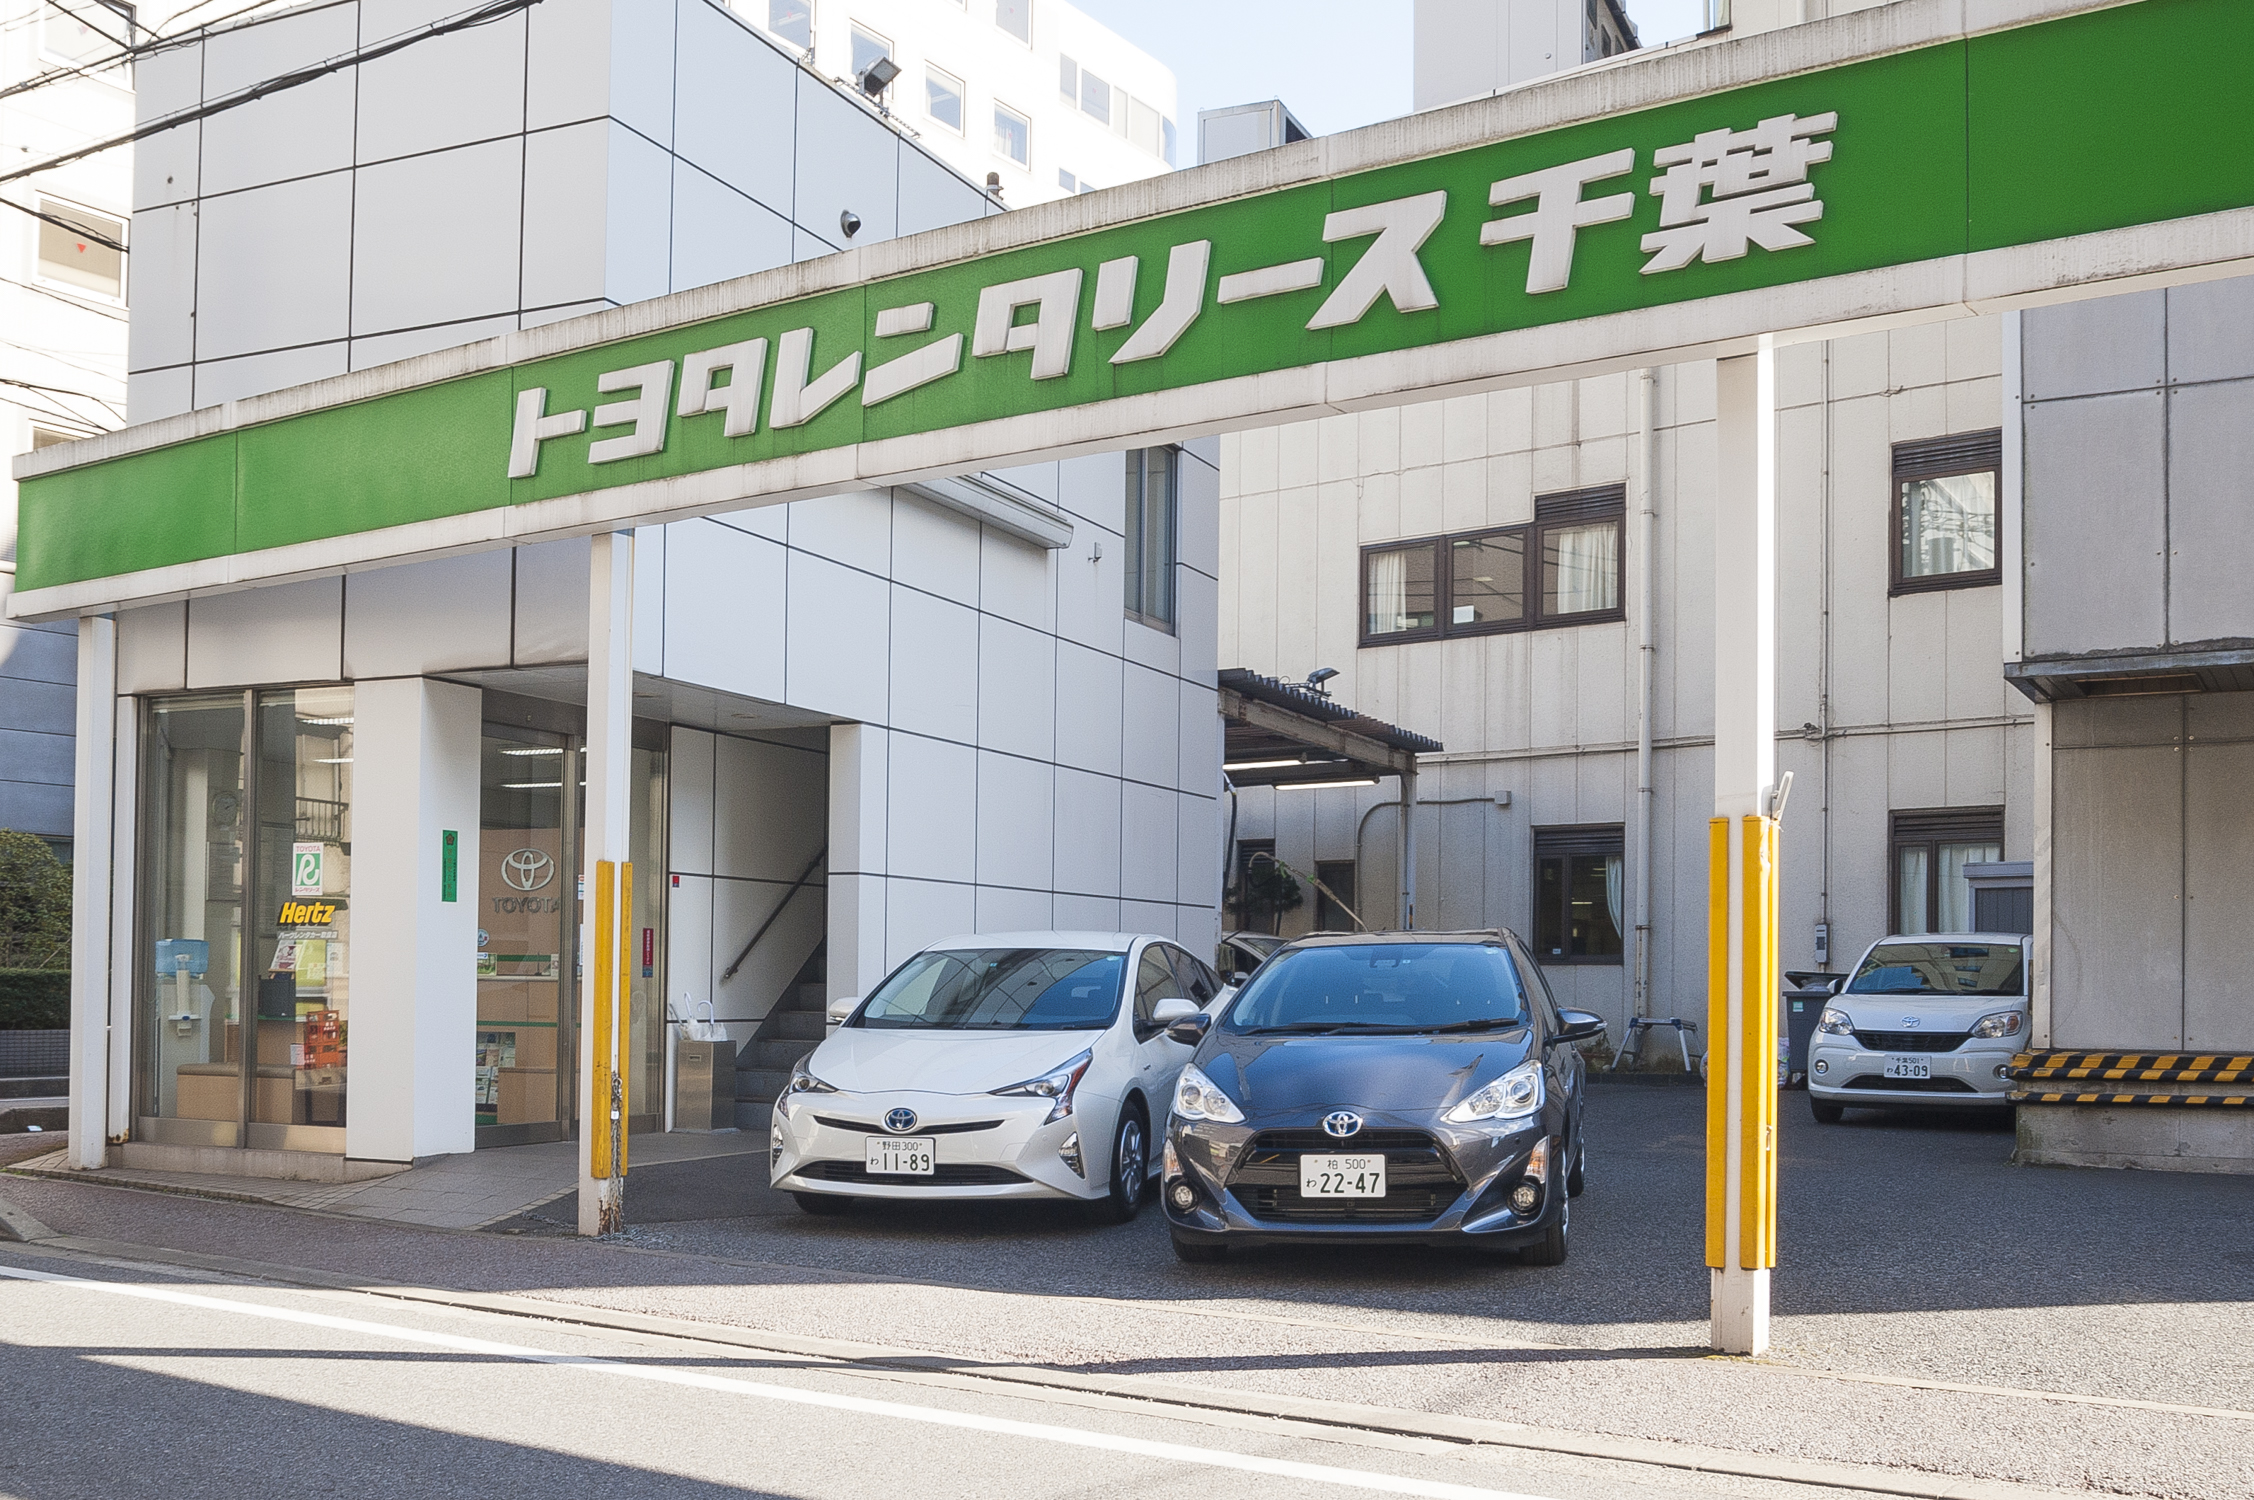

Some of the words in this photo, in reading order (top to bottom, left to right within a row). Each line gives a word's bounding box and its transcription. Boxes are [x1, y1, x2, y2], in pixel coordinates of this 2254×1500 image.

[279, 902, 336, 924] Hertz
[1894, 1064, 1928, 1077] 43-09
[870, 1156, 879, 1165] わ
[884, 1153, 929, 1171] 11-89
[1327, 1159, 1338, 1170] 柏
[1345, 1159, 1366, 1170] 500
[1306, 1178, 1317, 1188] わ
[1320, 1172, 1380, 1193] 22-47
